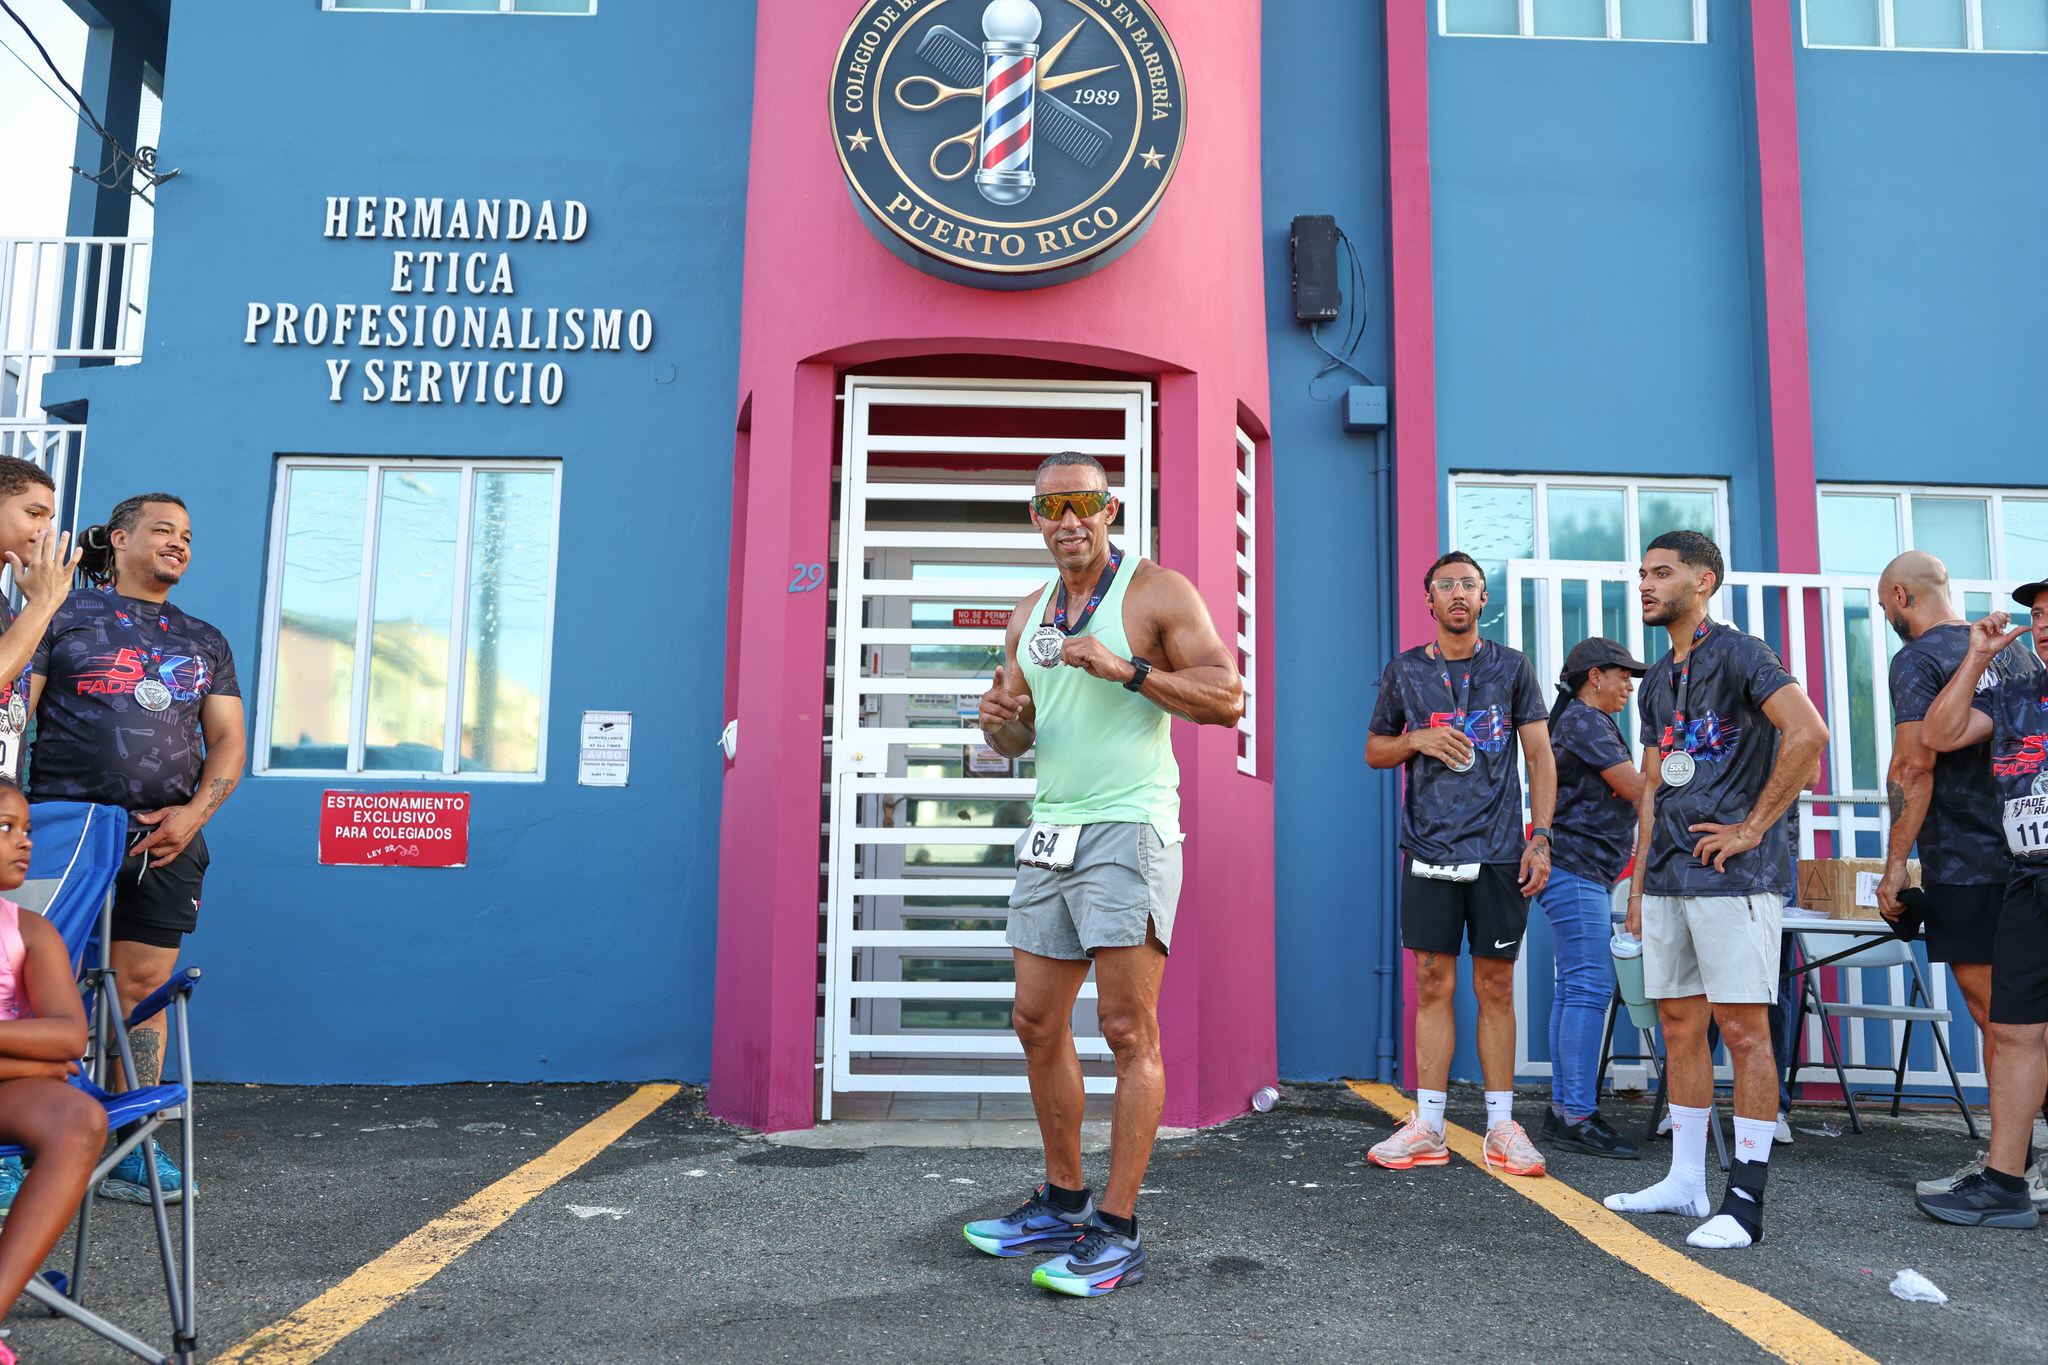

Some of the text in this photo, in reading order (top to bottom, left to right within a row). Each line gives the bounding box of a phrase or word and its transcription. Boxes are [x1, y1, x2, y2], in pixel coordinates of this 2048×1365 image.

[845, 6, 900, 113] COLEGIO DE
[1111, 3, 1173, 121] EN BARBERÍA
[1072, 89, 1120, 105] 1989
[323, 196, 589, 241] HERMANDAD
[885, 191, 1118, 256] PUERTO RICO
[390, 250, 515, 294] ETICA
[244, 302, 653, 351] PROFESIONALISMO
[326, 359, 564, 406] Y SERVICIO
[788, 563, 825, 593] 29
[77, 680, 138, 695] FADE
[585, 714, 628, 722] WARNING
[587, 750, 622, 759] AVISO
[1993, 763, 2038, 776] FADE
[327, 796, 464, 811] ESTACIONAMIENTO
[353, 811, 436, 824] EXCLUSIVO
[335, 826, 453, 840] PARA COLEGIADOS
[1032, 830, 1060, 858] 64
[366, 844, 395, 859] LEY 22
